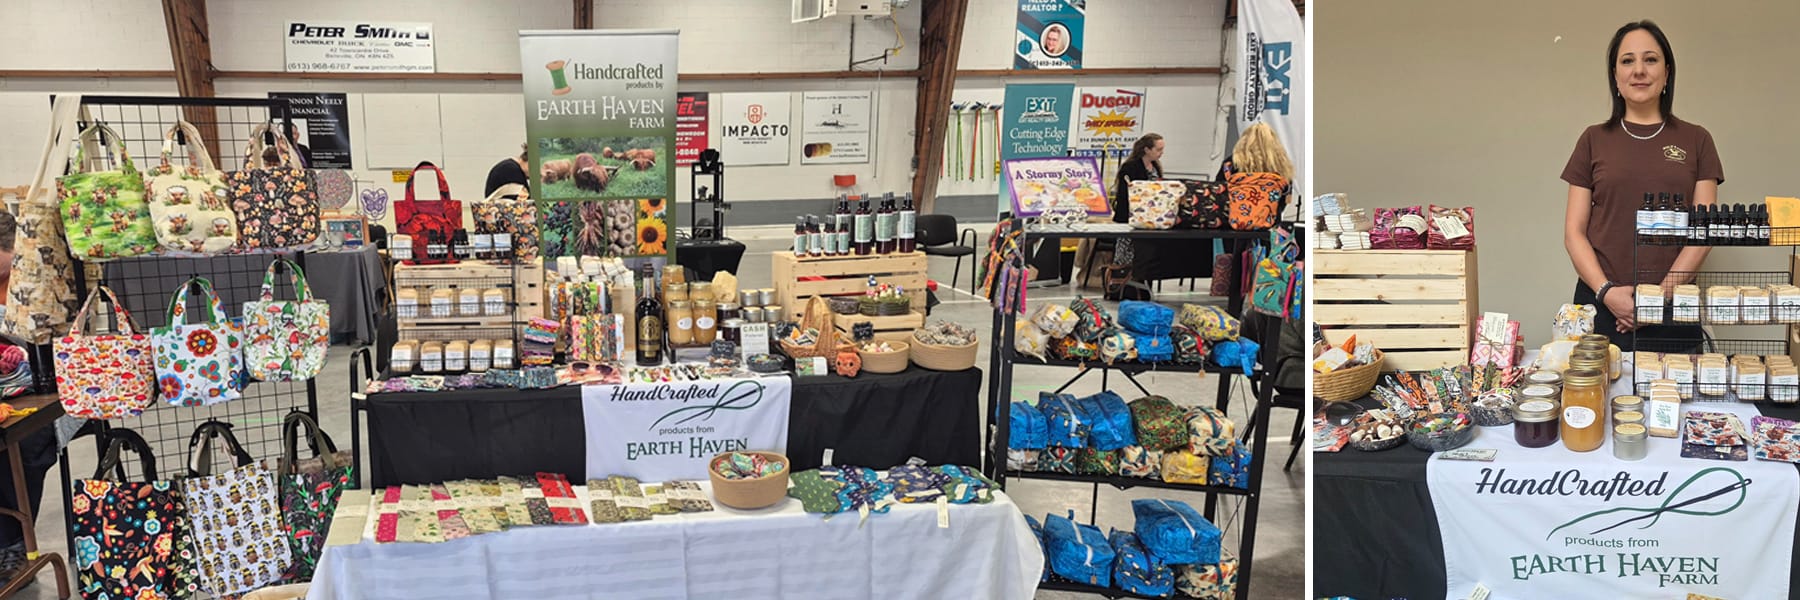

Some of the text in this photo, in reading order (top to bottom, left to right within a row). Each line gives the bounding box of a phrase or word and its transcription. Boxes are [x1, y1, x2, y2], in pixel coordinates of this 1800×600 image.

[1021, 4, 1057, 12] REALTOR
[289, 23, 345, 38] PETER
[288, 63, 311, 71] (613)
[574, 63, 663, 80] Handcrafted
[1247, 54, 1257, 88] REALTY
[625, 81, 664, 91] products by
[1262, 42, 1292, 116] EXIT
[537, 95, 664, 120] EARTH HAVEN
[832, 103, 842, 115] H
[1026, 97, 1057, 113] EXIT
[629, 117, 665, 129] FARM
[722, 124, 789, 137] IMPACTO
[1009, 126, 1066, 142] Cutting Edge
[1011, 141, 1063, 156] Technology
[1015, 167, 1093, 180] A Stormy Story
[742, 325, 766, 333] CASH
[610, 384, 720, 403] HandCrafted
[659, 426, 715, 436] products from
[626, 437, 748, 461] EARTH HAVEN
[1475, 467, 1668, 502] HandCrafted
[1565, 536, 1659, 548] products from
[1510, 552, 1719, 581] EARTH HAVEN
[1659, 573, 1719, 588] FARM
